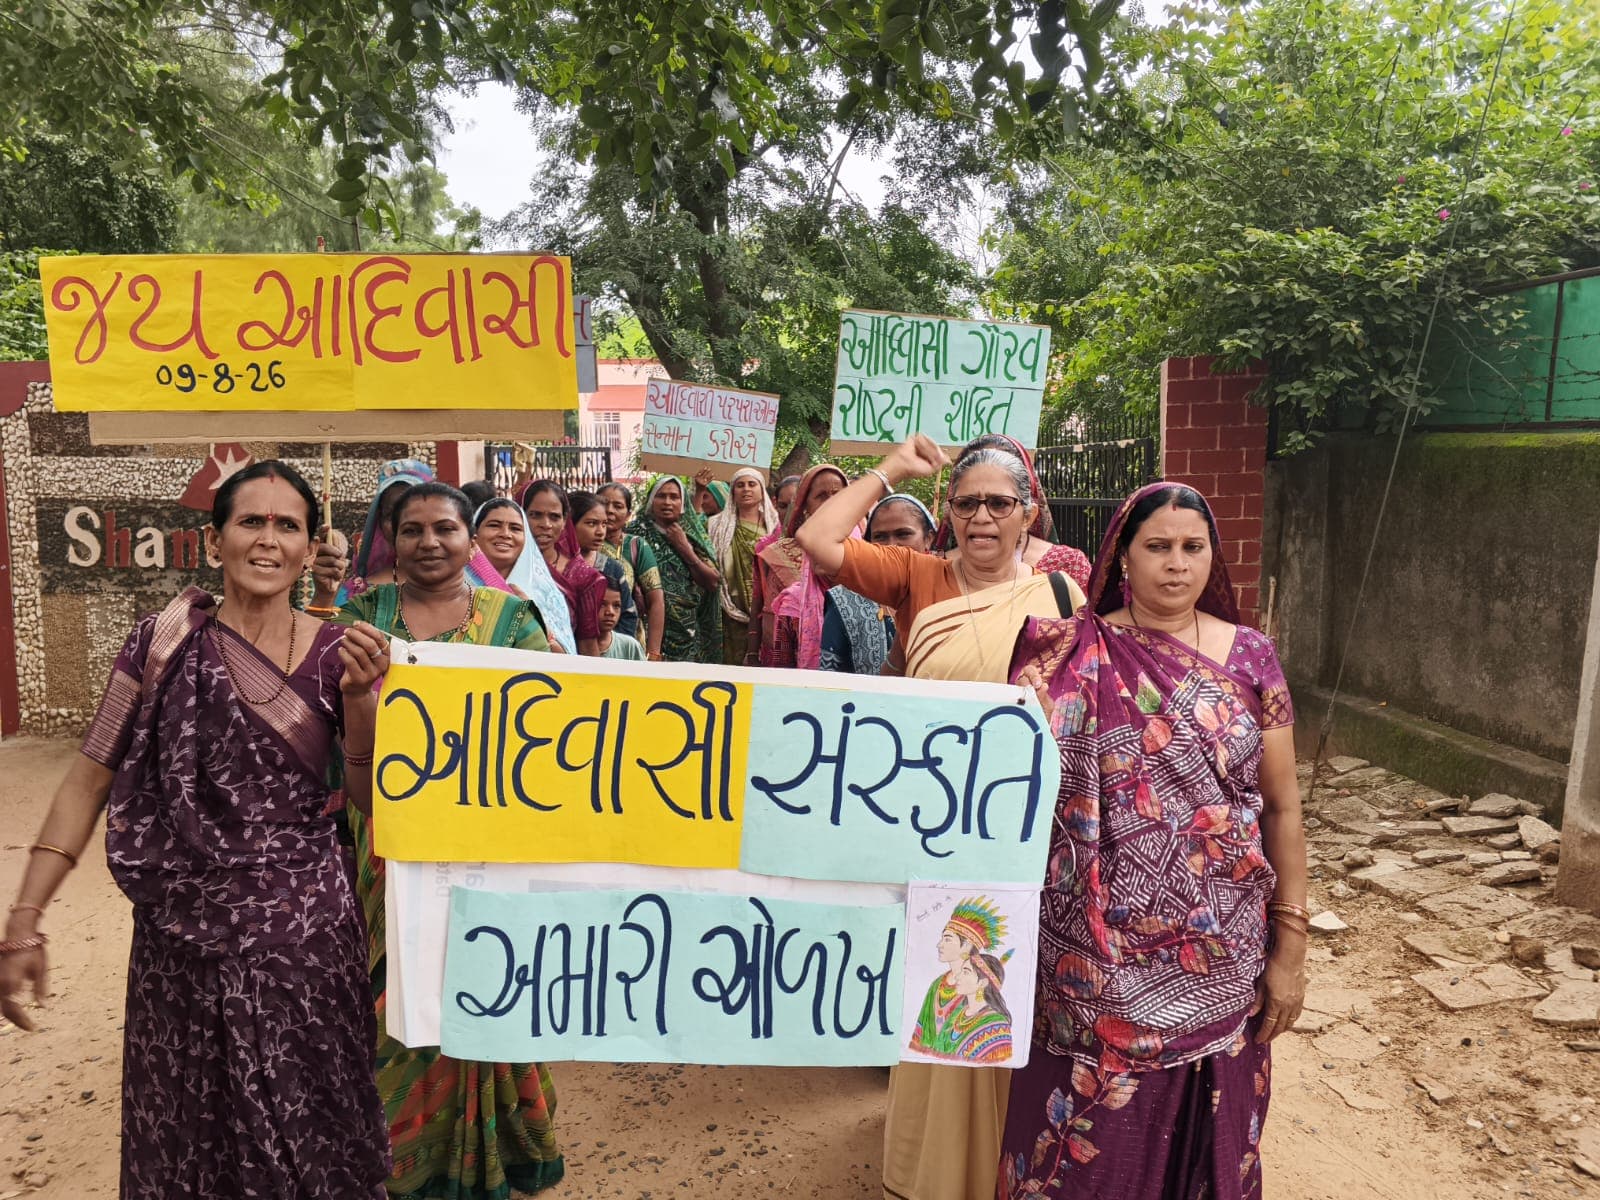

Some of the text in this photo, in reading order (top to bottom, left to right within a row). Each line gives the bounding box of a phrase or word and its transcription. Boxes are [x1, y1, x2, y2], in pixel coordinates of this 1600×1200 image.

[52, 271, 219, 365] જય
[236, 256, 571, 366] આદિવાસી
[155, 361, 286, 393] 09-8-26
[64, 505, 222, 569] Shan
[376, 672, 1044, 858] આદિવાસી સંસ્કૃતિ
[455, 893, 897, 1039] અમારી ઓળખ
